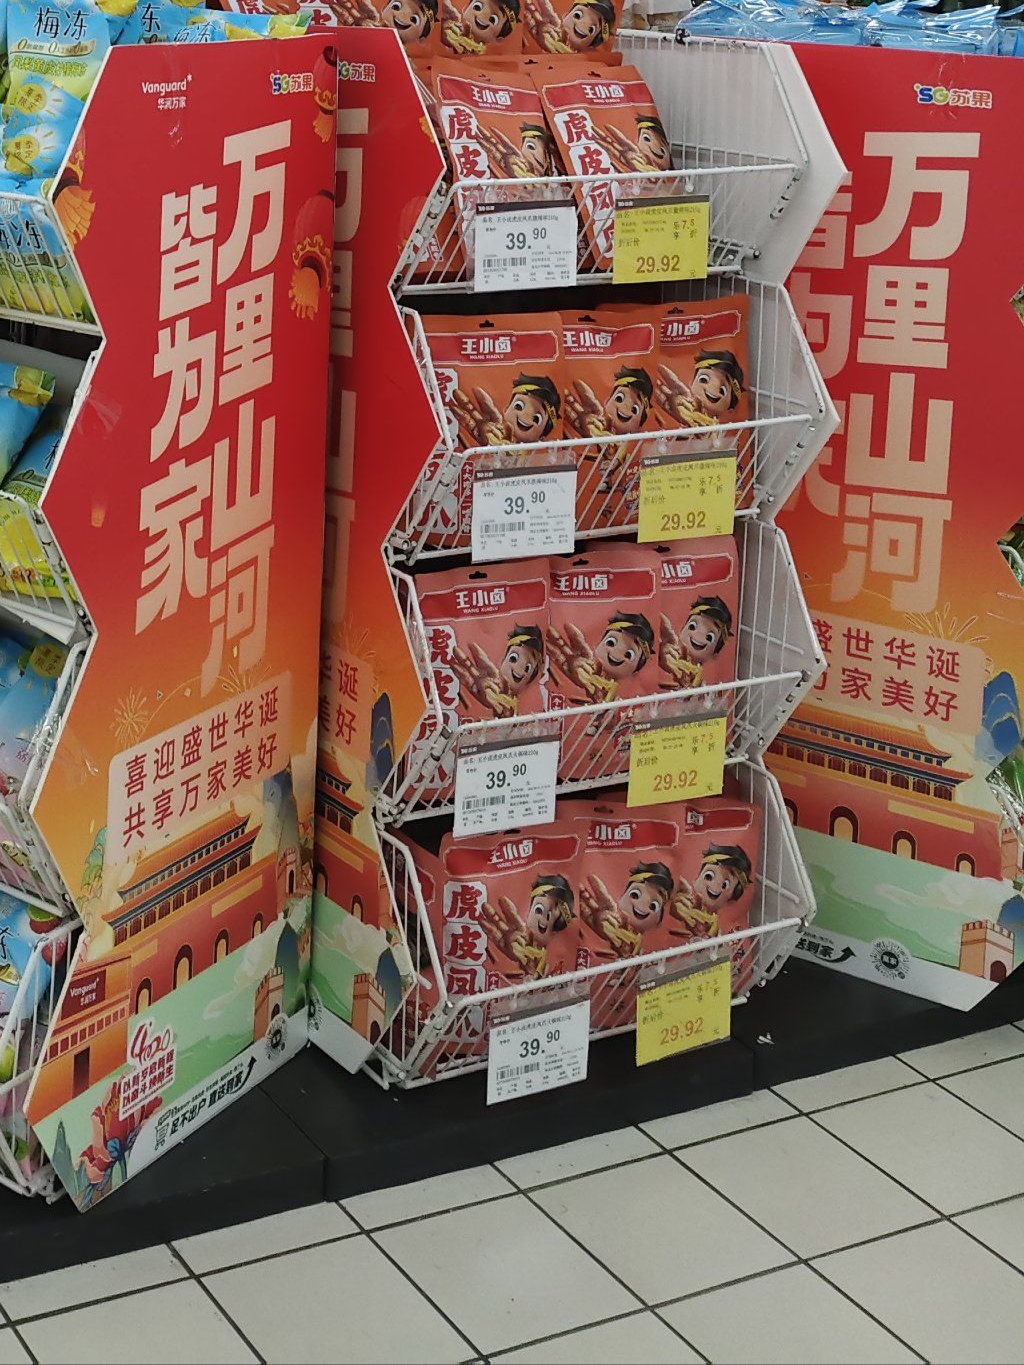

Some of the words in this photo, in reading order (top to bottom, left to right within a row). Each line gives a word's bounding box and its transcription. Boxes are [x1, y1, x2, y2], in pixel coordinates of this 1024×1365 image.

[36, 7, 91, 39] 梅冻
[141, 78, 188, 97] Vanguard
[471, 85, 512, 106] 王小卤
[584, 83, 624, 99] 王小卤
[636, 254, 680, 274] 29.92
[461, 338, 512, 355] 王小卤
[563, 331, 612, 347] 王小卤
[831, 131, 980, 613] 万里山河
[136, 182, 217, 635] 皆为家
[201, 120, 292, 697] 万里山河
[660, 510, 706, 531] 29.92
[555, 573, 610, 592] 王小卤
[456, 587, 506, 609] 王小卤
[124, 685, 280, 797] 喜迎盛世华诞
[122, 733, 278, 847] 共享万家美好
[653, 770, 698, 793] 29.92
[490, 840, 535, 864] 王小卤
[660, 1018, 705, 1046] 29.92
